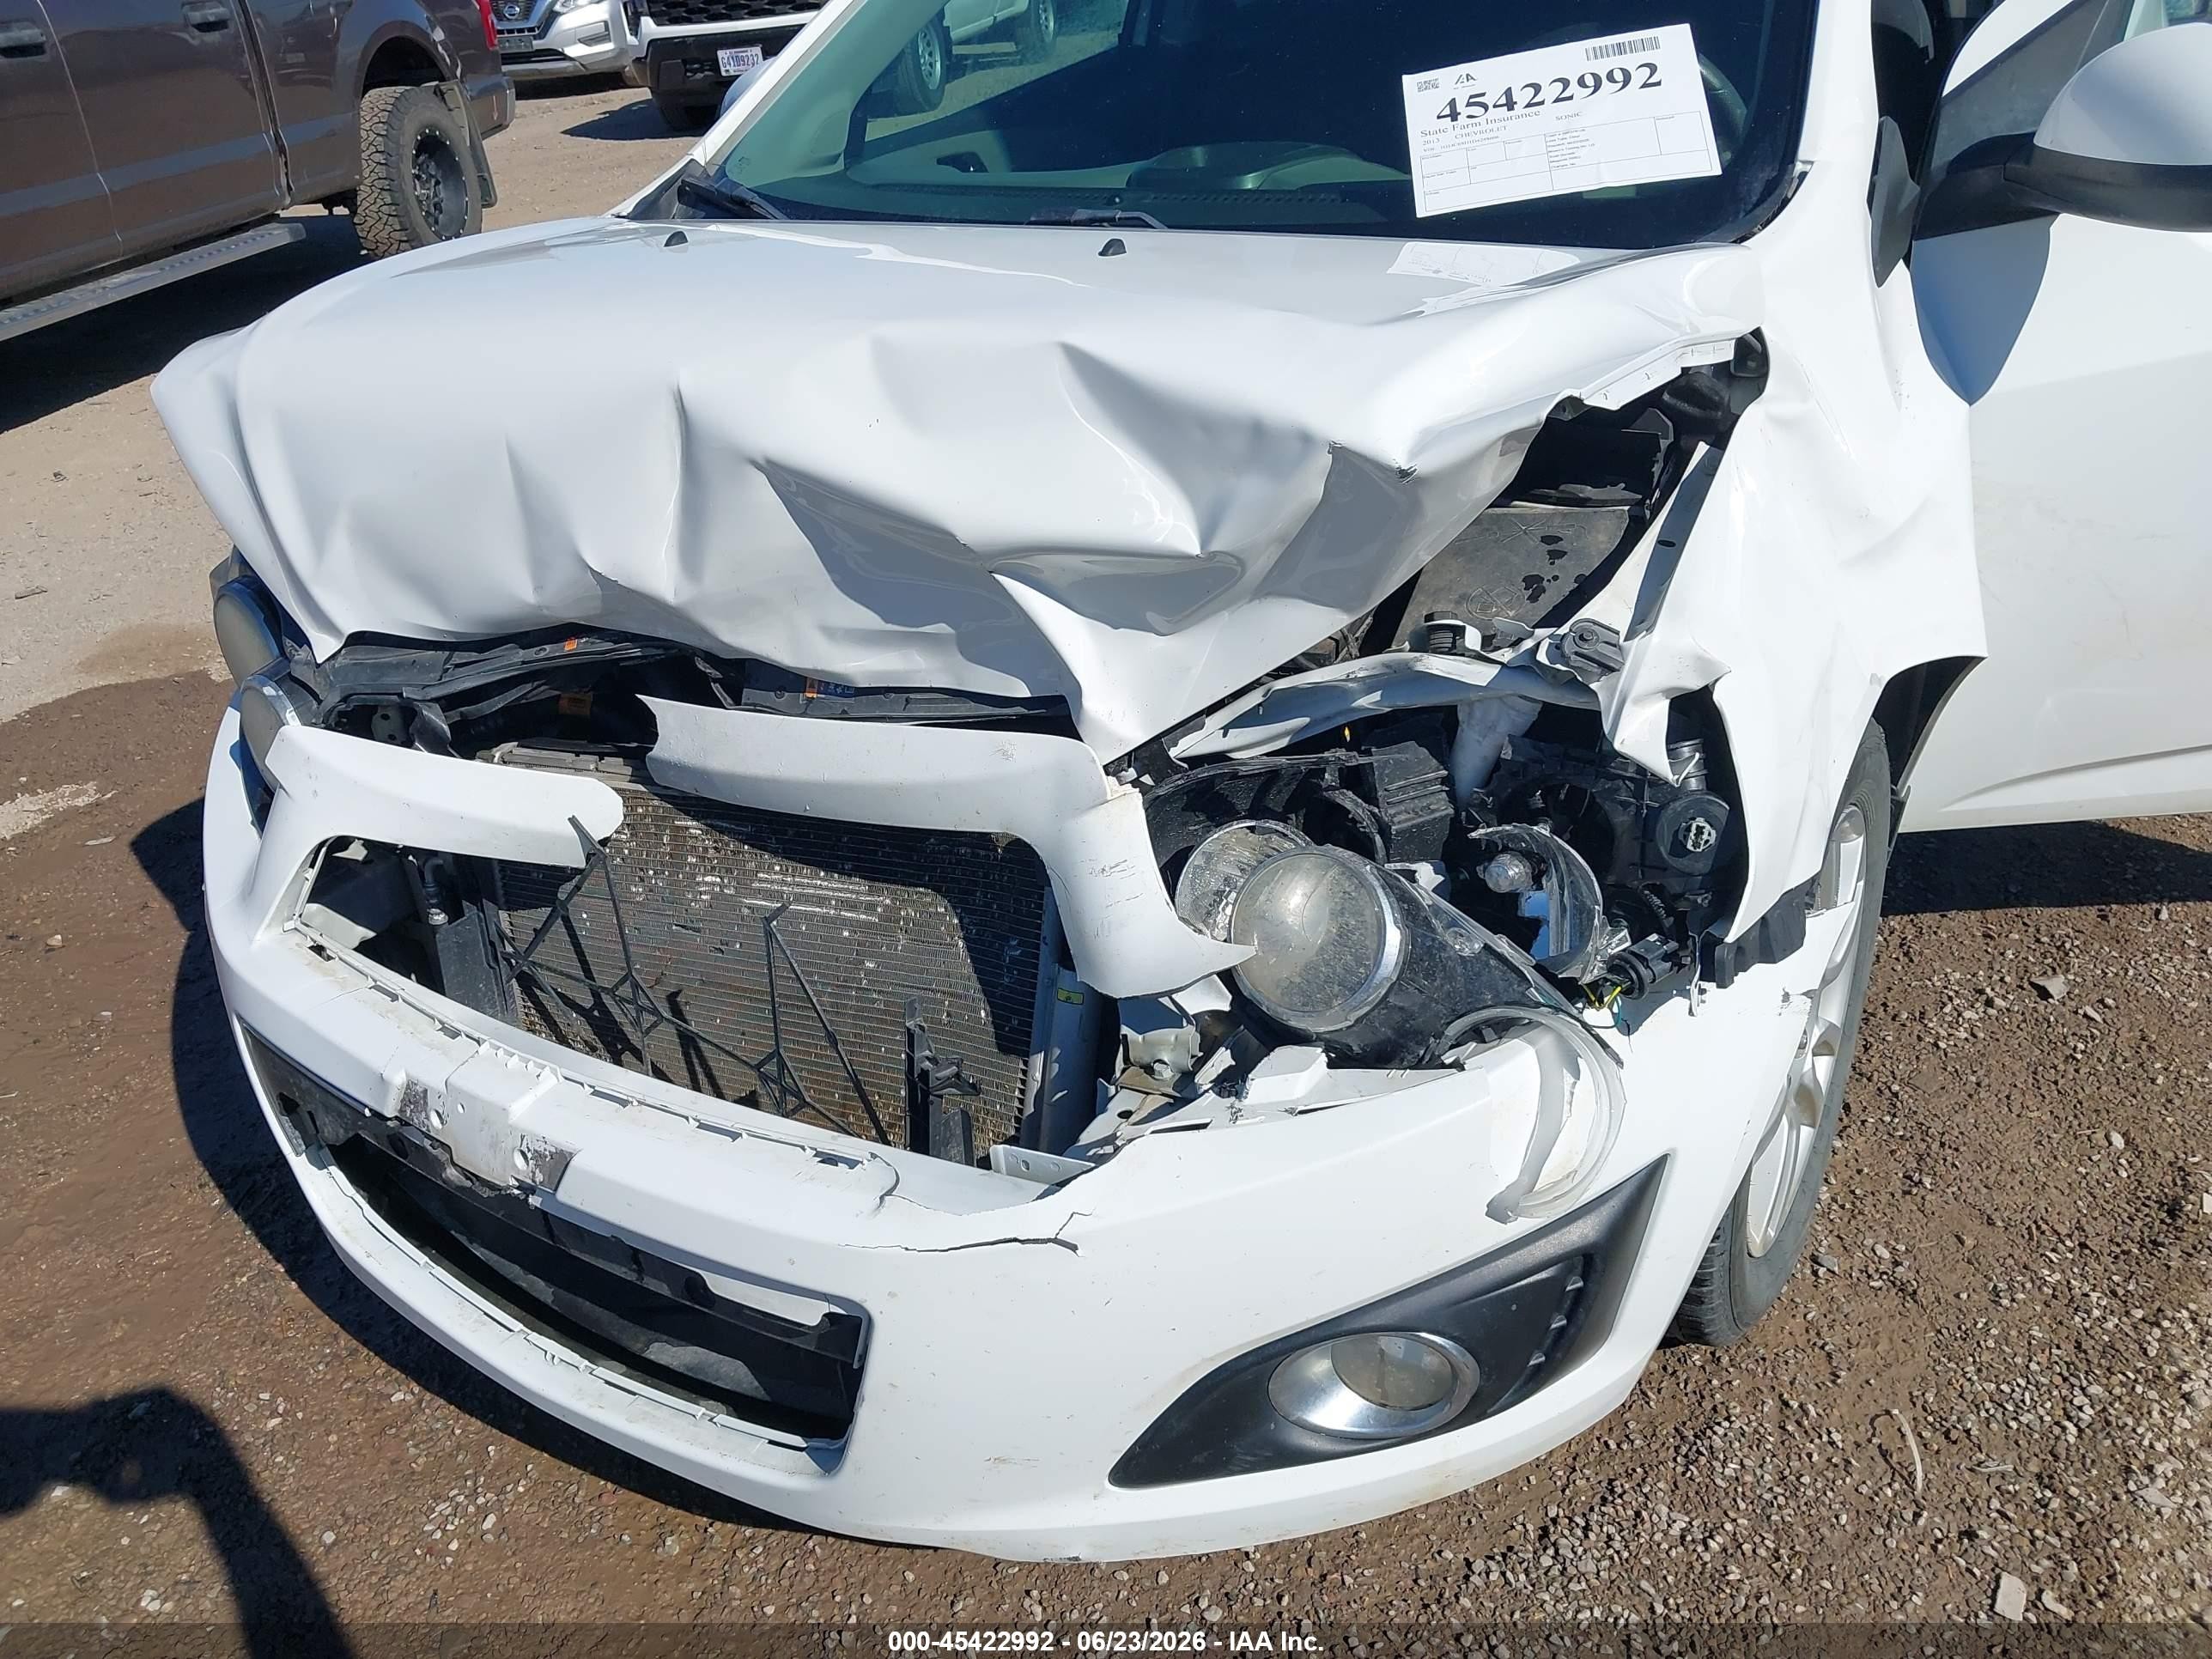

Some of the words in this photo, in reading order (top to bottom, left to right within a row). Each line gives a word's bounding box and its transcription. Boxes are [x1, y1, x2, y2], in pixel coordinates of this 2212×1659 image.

[1436, 62, 1662, 122] 45422992
[1420, 130, 1449, 138] State
[1452, 122, 1481, 131] Farm
[1486, 110, 1540, 125] Insurance
[1455, 125, 1508, 139] CHEVROLET
[1555, 112, 1582, 121] SONIC
